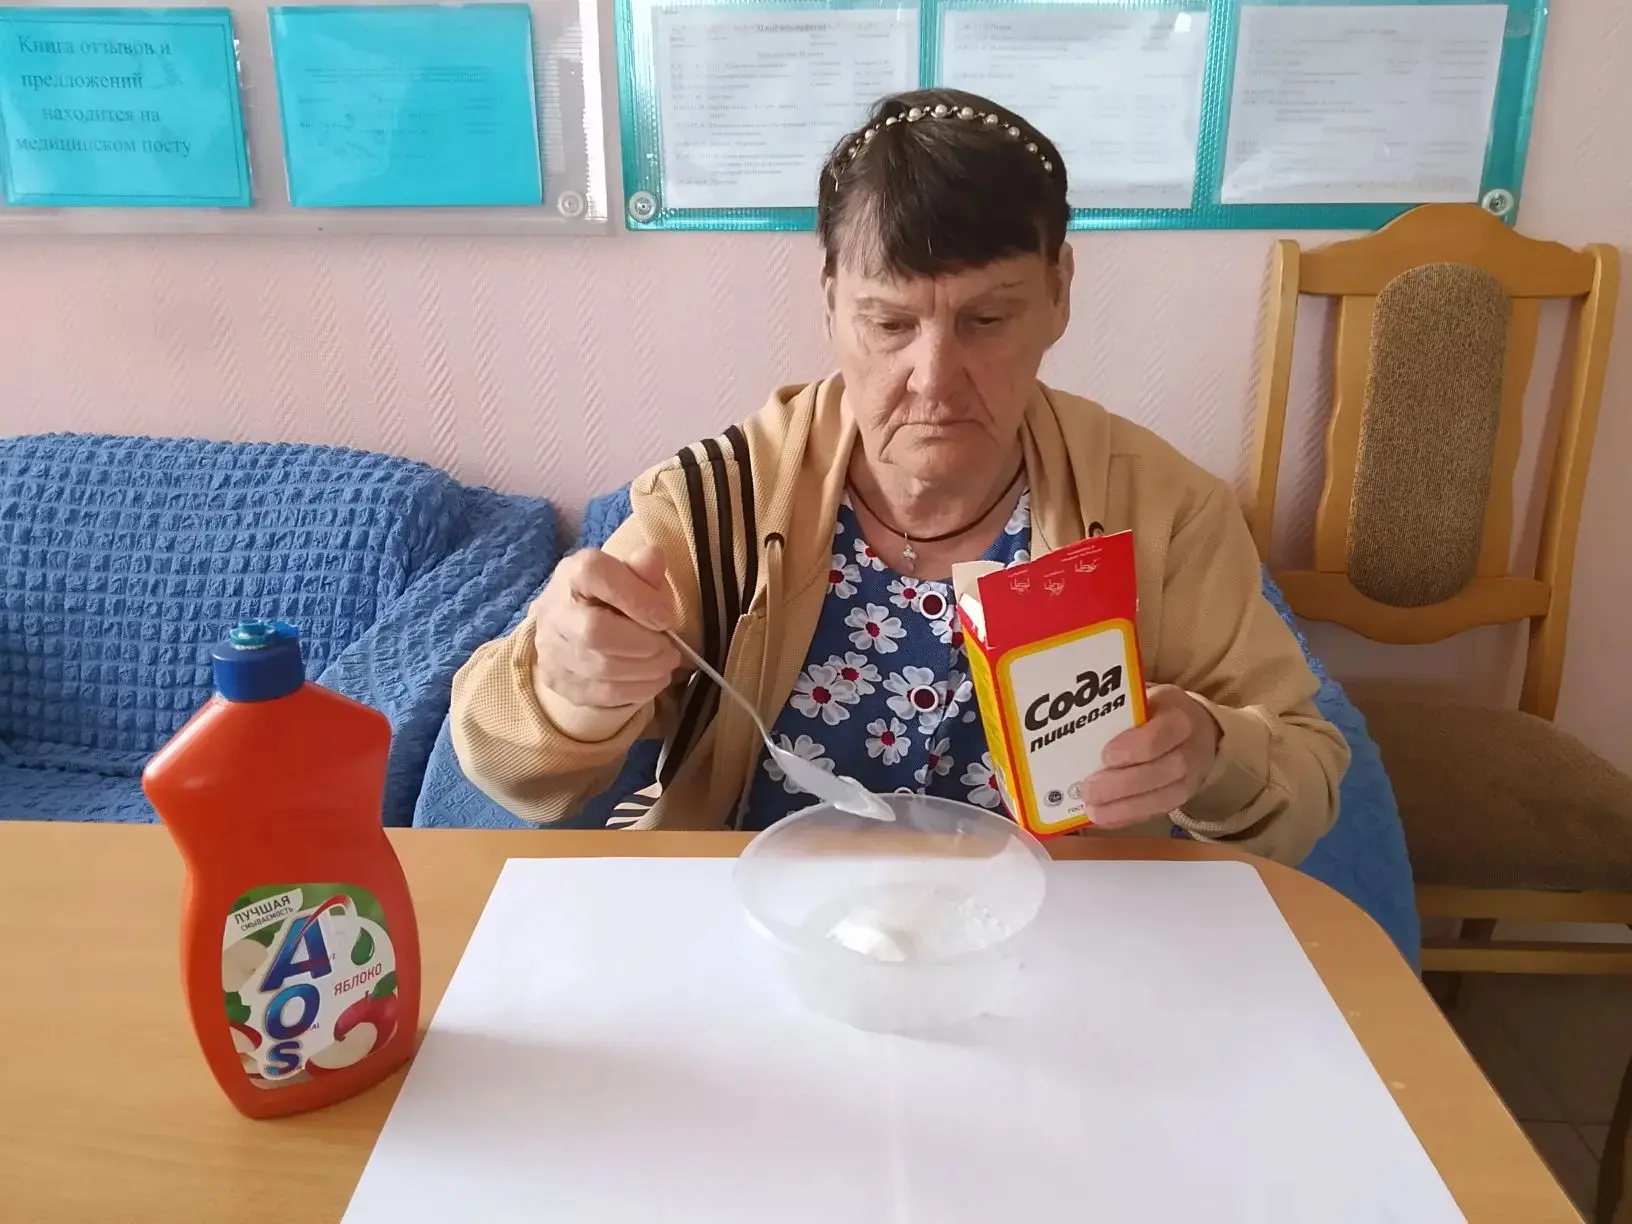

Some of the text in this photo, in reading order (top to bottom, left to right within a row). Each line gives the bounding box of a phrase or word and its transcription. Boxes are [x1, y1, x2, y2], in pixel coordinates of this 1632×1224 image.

[18, 35, 171, 56] Книга отзывов и
[21, 71, 144, 91] предложений
[42, 107, 161, 123] находится на
[16, 137, 191, 158] медицинском посту
[1023, 664, 1123, 732] Сода
[1030, 693, 1126, 753] пищевая
[234, 895, 291, 925] ЛУЧШАЯ
[240, 906, 294, 932] СМЫВАЕМОСТЬ
[333, 963, 383, 997] ЯБЛОКО
